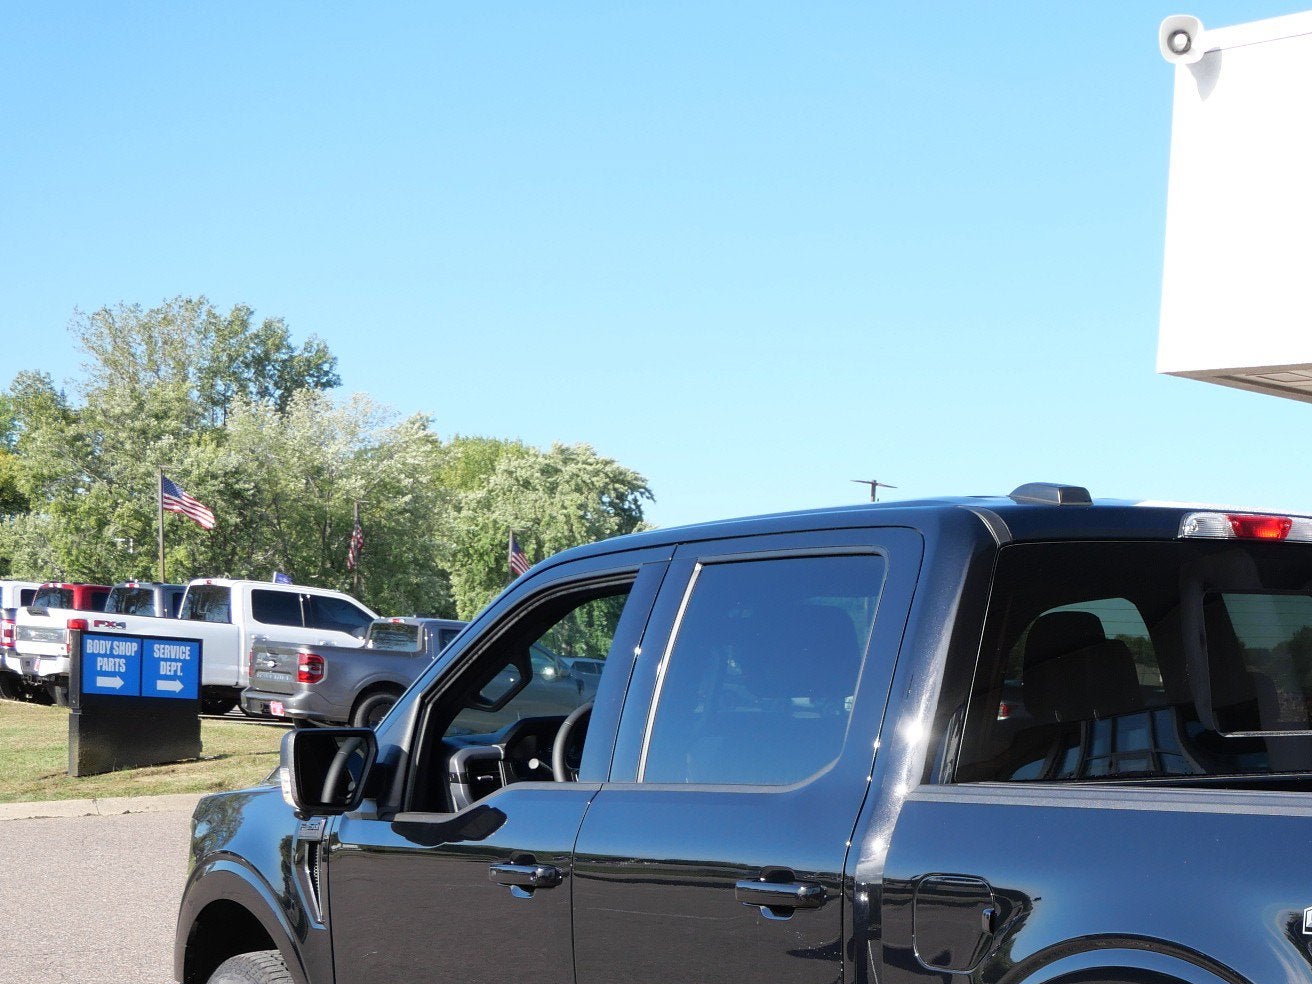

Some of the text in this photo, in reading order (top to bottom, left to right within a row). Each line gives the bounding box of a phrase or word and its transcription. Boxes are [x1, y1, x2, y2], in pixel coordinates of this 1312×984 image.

[86, 639, 138, 656] BODY SHOP
[153, 643, 191, 660] SERVICE
[96, 656, 126, 673] PARTS
[159, 661, 183, 676] DEPT.
